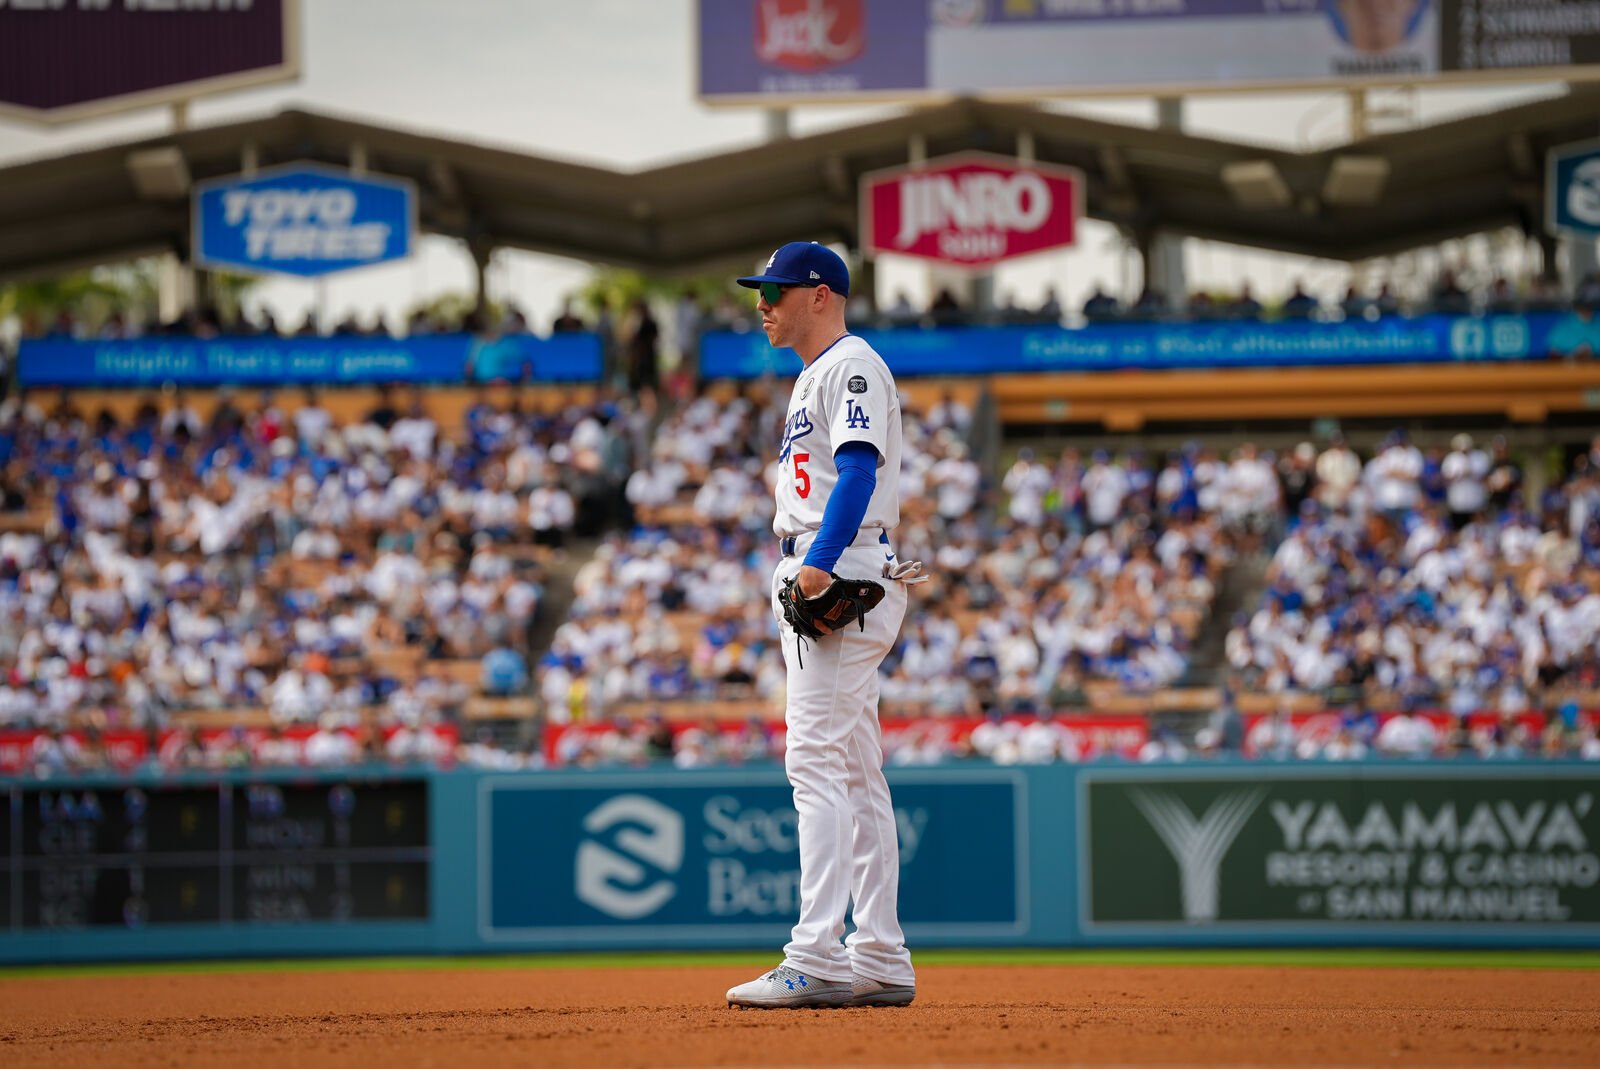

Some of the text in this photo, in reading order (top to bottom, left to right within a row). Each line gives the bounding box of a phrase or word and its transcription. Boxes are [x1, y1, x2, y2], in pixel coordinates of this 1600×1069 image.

[222, 188, 358, 226] TOYO
[895, 171, 1053, 249] JINRO
[244, 222, 392, 260] TIRES
[850, 381, 865, 392] 34
[845, 399, 869, 429] LA
[793, 453, 811, 499] 5
[1265, 850, 1600, 888] RESORT & CASINO
[1325, 886, 1404, 921] SAN
[1410, 885, 1573, 921] MANUEL
